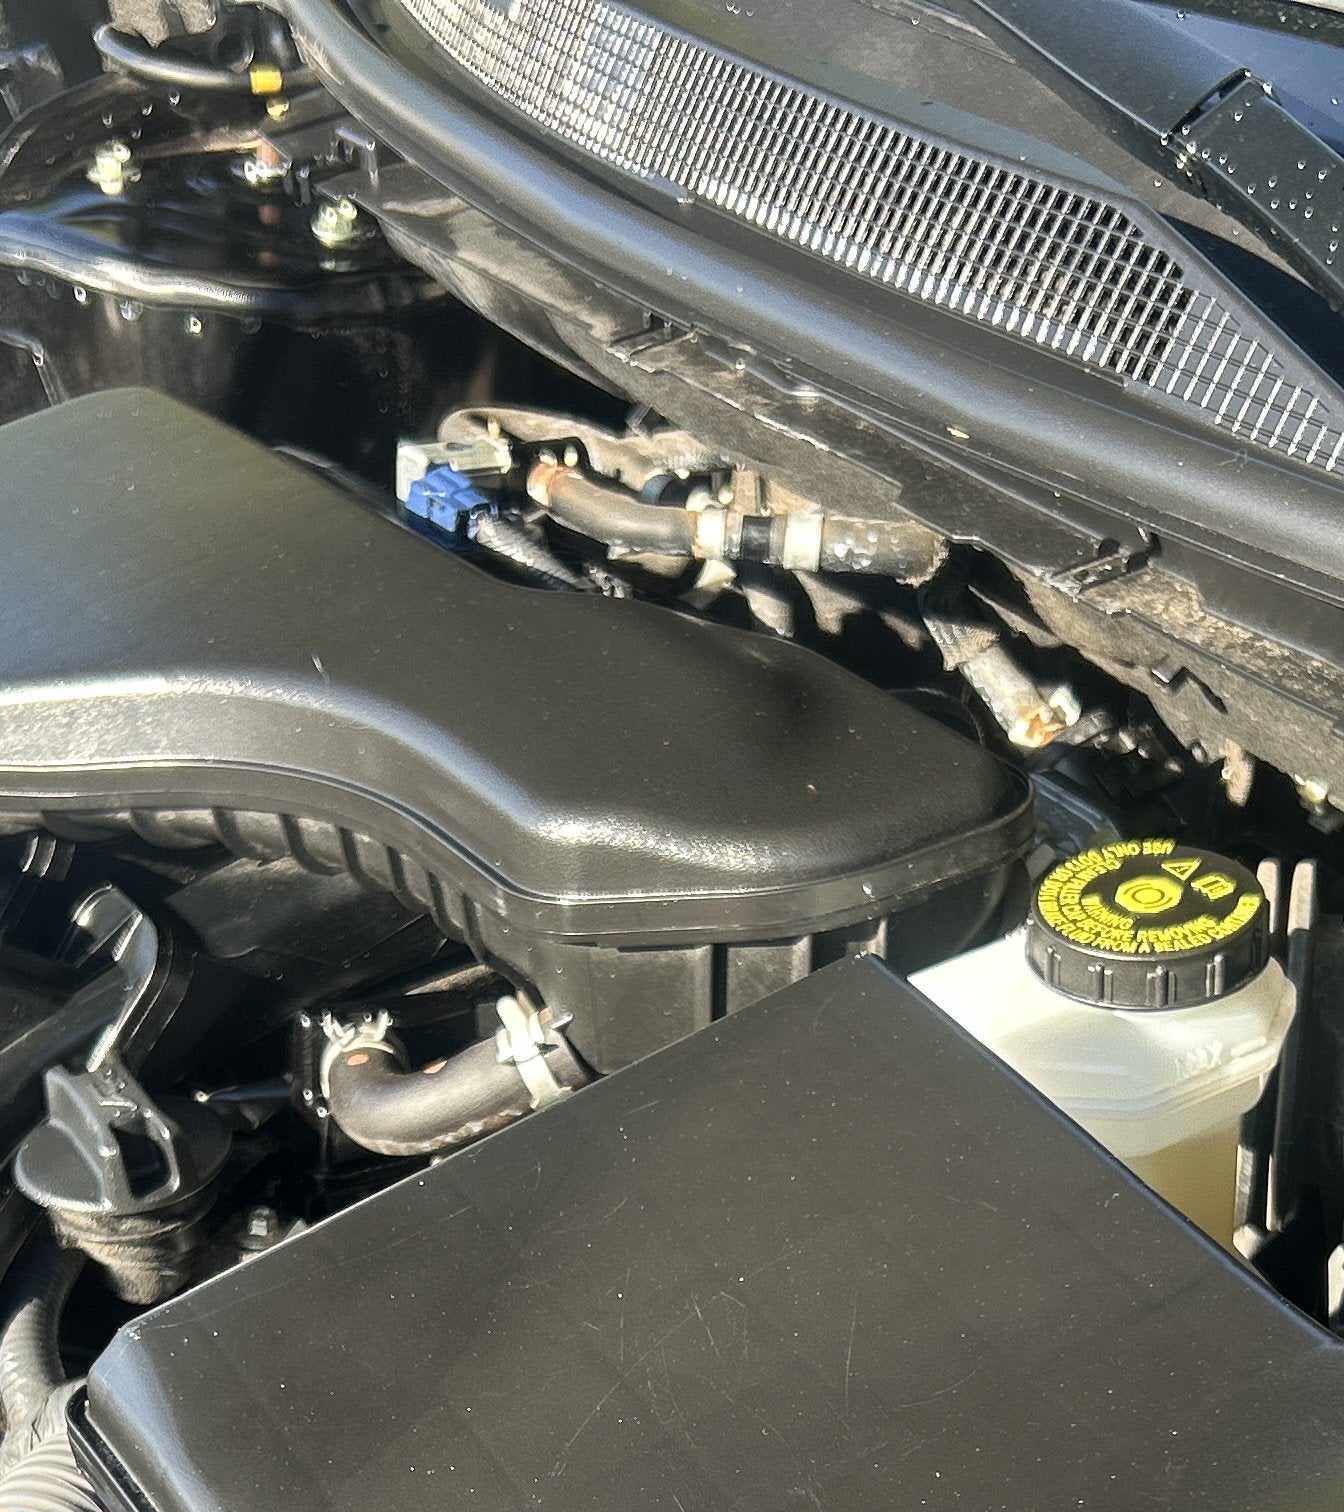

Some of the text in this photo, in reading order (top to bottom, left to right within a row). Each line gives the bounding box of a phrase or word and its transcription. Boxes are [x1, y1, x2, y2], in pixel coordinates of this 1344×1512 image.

[1102, 841, 1140, 859] ONLY
[1142, 839, 1175, 855] USE
[1058, 859, 1217, 942] CLEAN FILLER CAP BEFORE REMOVING
[1081, 895, 1134, 930] ARNING
[1055, 922, 1096, 944] FLUID
[1091, 937, 1138, 954] FROM
[1138, 940, 1151, 954] A
[1153, 933, 1212, 952] SEALED
